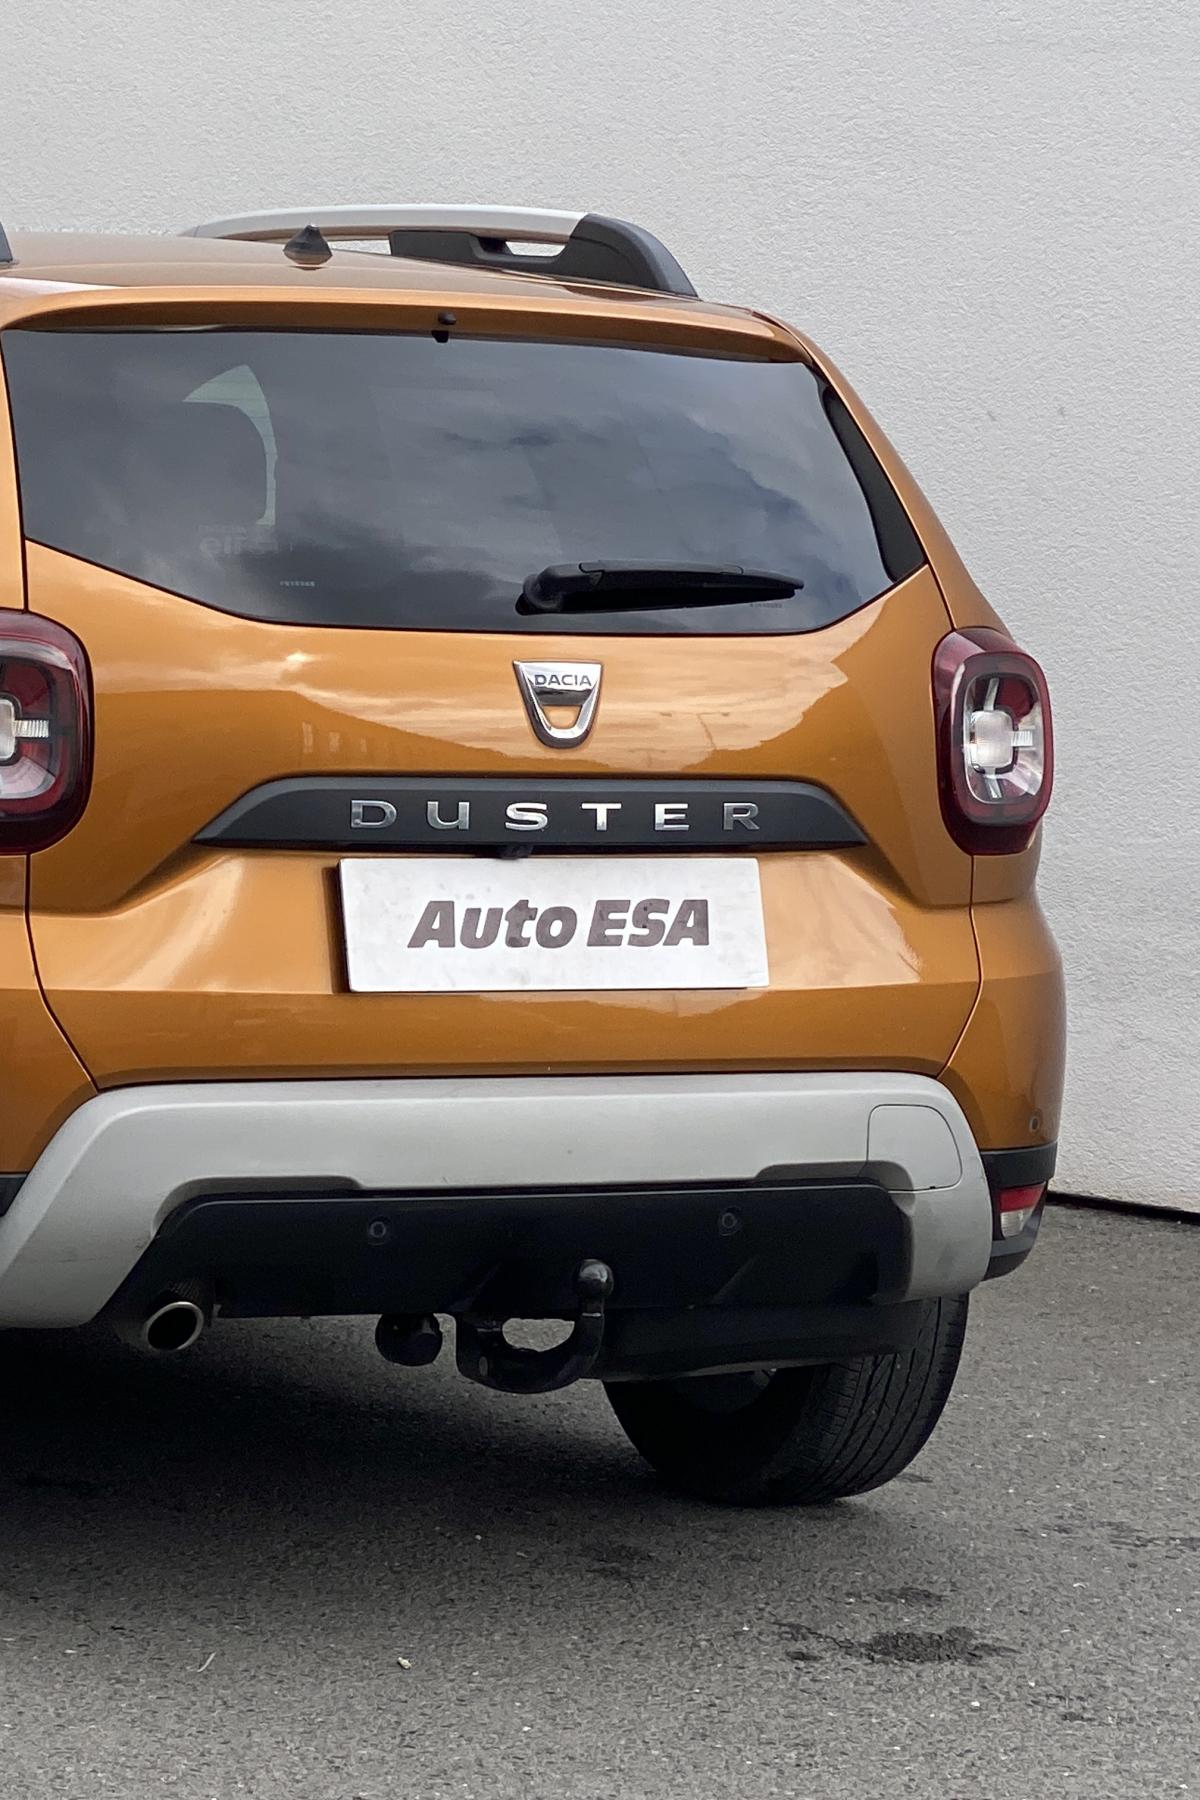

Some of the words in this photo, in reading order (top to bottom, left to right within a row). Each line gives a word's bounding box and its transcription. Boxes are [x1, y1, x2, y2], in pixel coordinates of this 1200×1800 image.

[534, 674, 592, 687] DACIA
[351, 799, 760, 832] DUSTER
[407, 899, 578, 949] Auto
[586, 898, 710, 948] ESA
